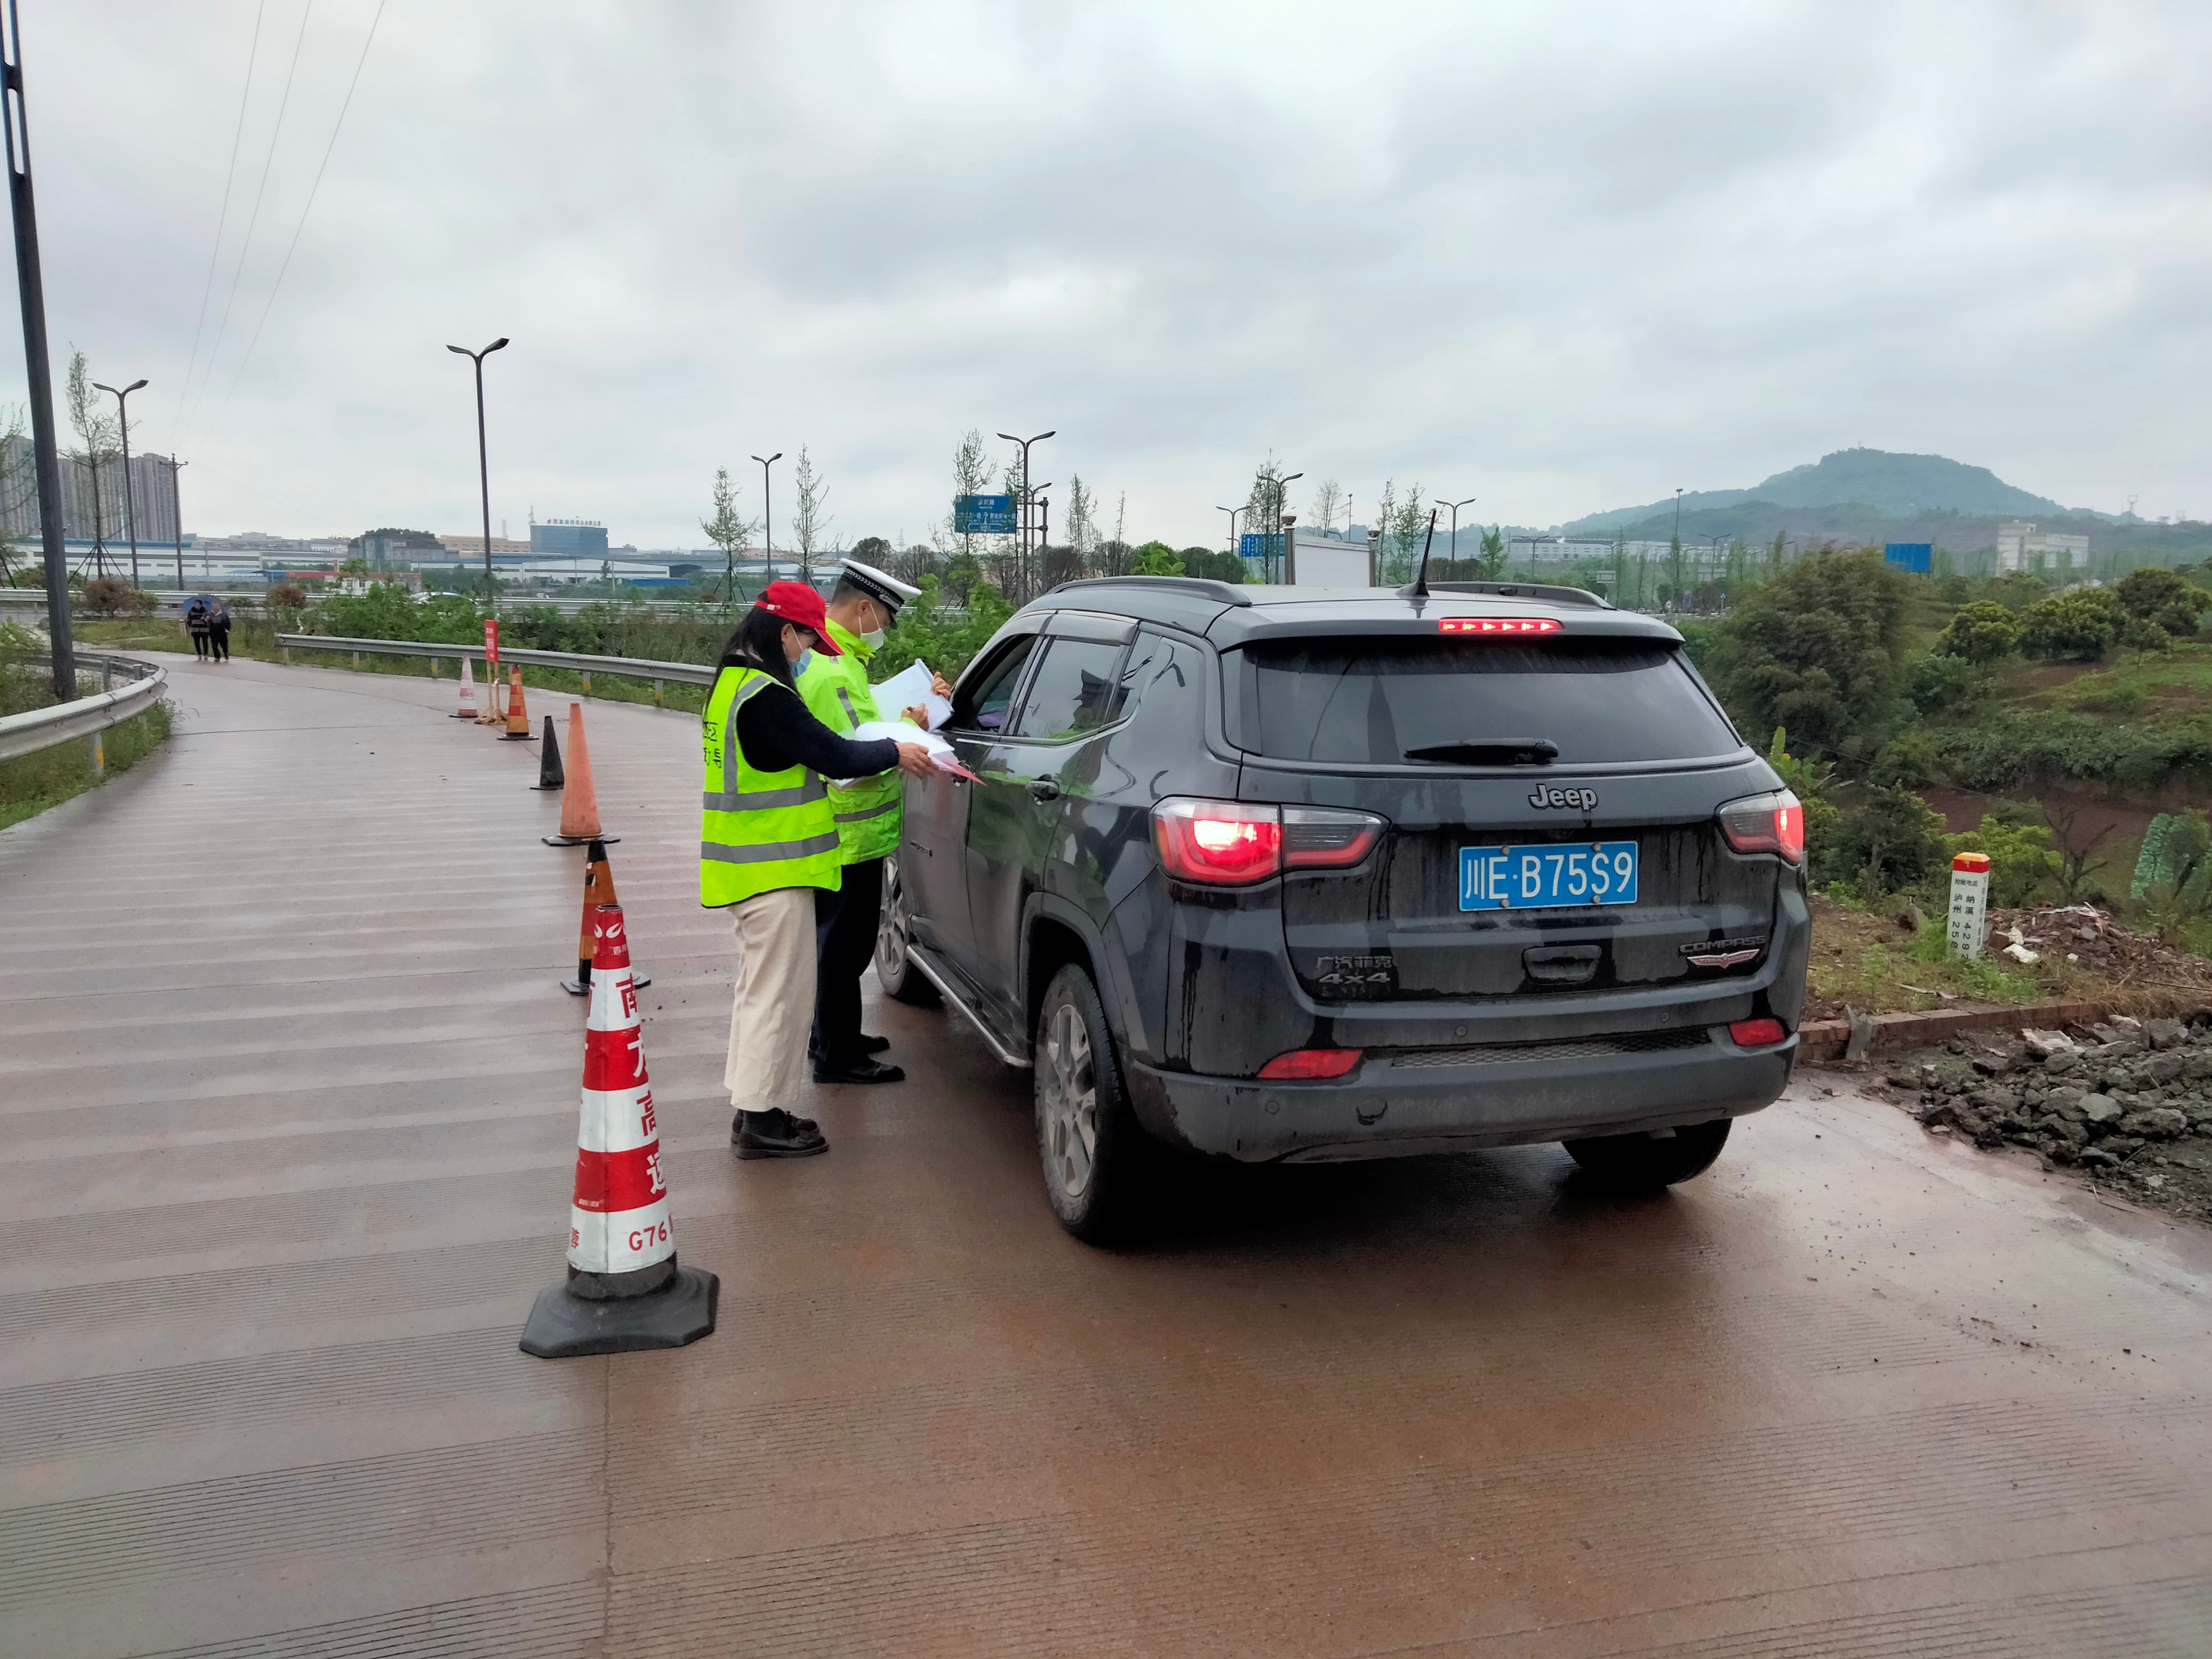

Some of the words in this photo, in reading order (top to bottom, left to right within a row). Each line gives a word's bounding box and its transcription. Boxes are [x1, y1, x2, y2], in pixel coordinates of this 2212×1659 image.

[1528, 784, 1597, 811] Jeep
[1952, 893, 1963, 914] 泸州
[1965, 895, 1975, 916] 纳溪
[1680, 935, 1765, 953] COMPASS
[1316, 956, 1393, 969] 广汽菲克
